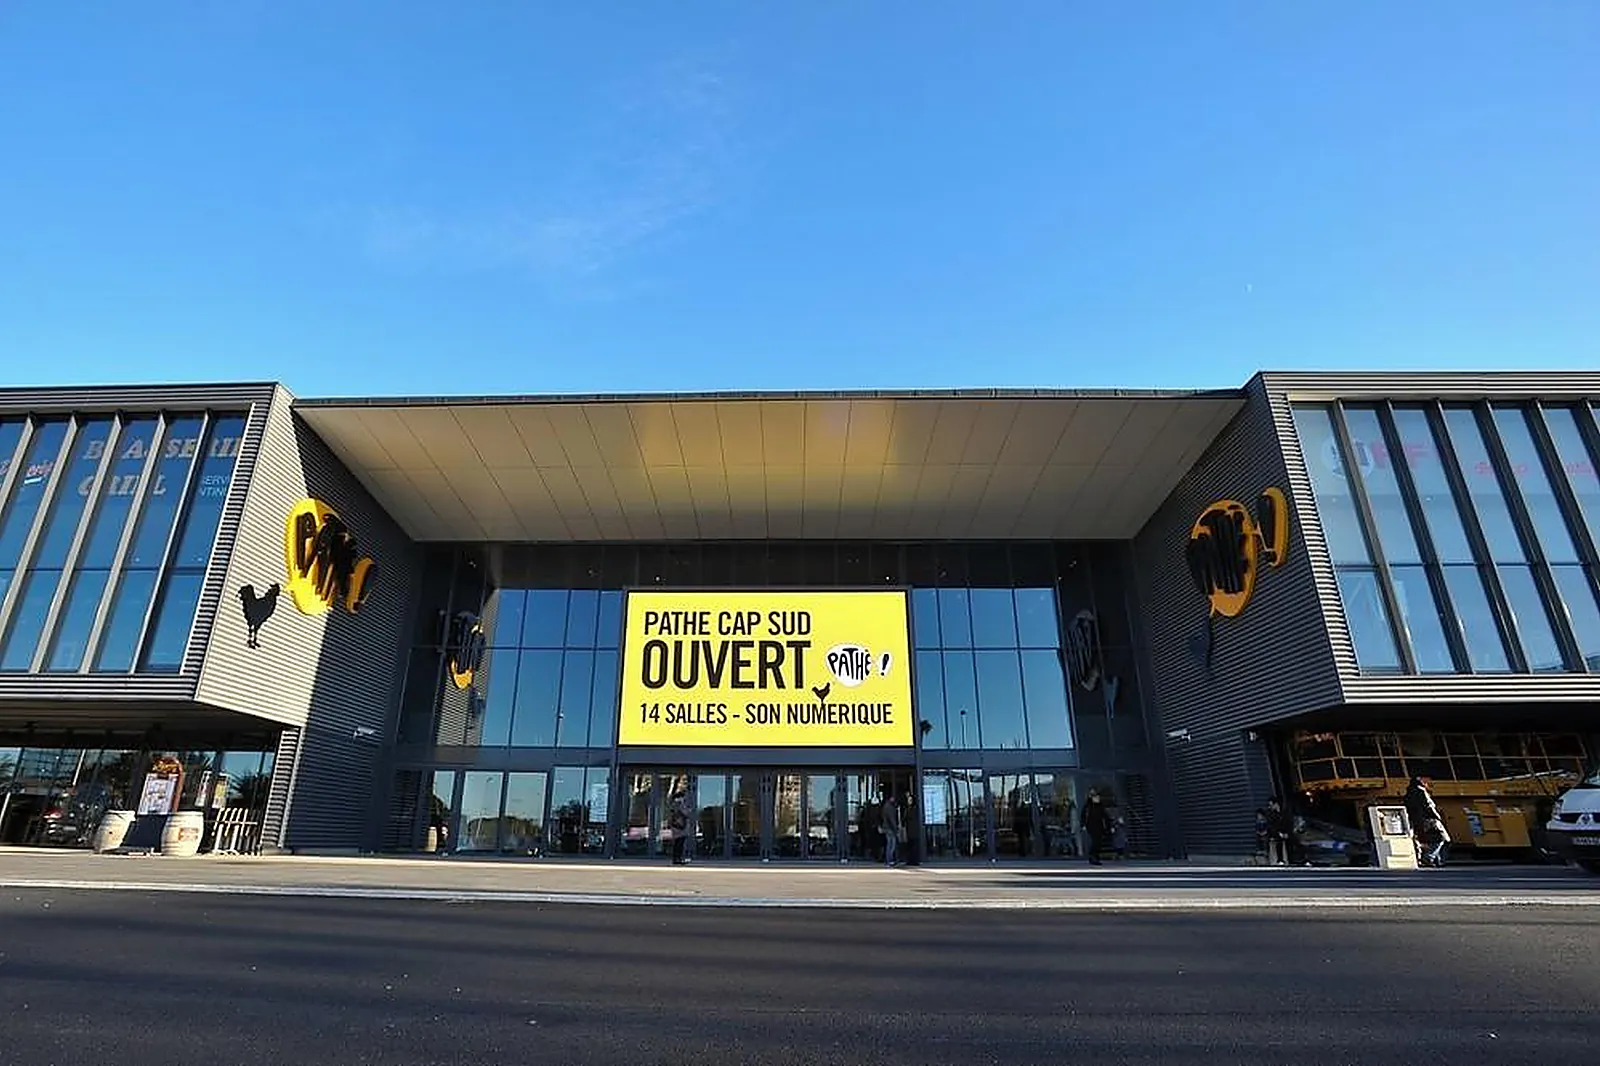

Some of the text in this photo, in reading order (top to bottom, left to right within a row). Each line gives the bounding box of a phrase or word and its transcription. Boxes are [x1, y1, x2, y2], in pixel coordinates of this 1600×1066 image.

[645, 611, 811, 636] PATHE CAP SUD
[641, 639, 813, 689] OUVERT
[640, 703, 660, 724] 14
[665, 703, 728, 725] SALLES
[745, 703, 781, 725] SON
[787, 703, 894, 725] NUMERIQUE
